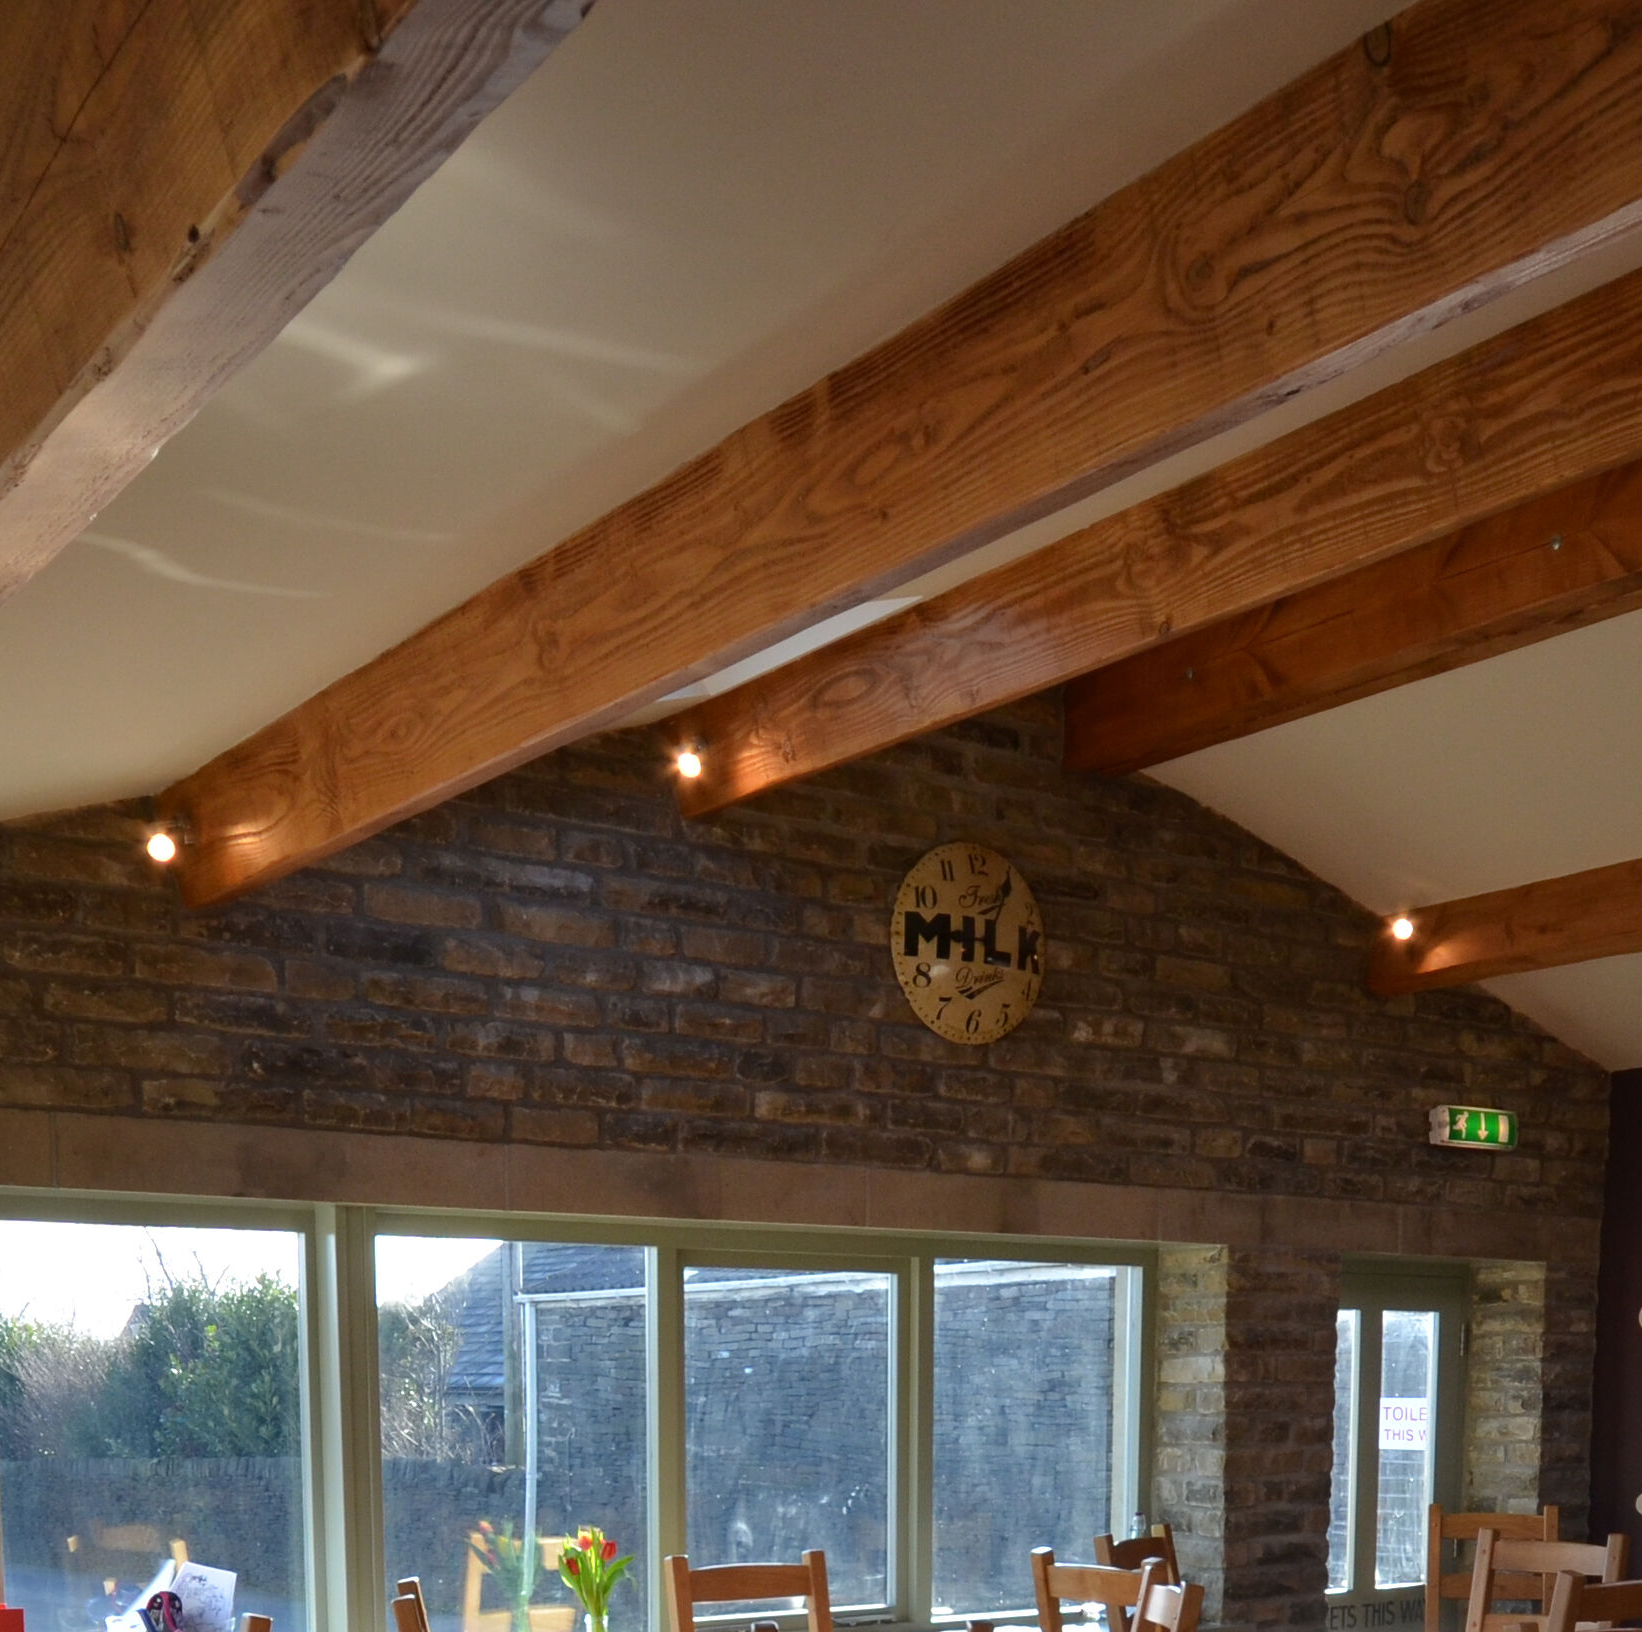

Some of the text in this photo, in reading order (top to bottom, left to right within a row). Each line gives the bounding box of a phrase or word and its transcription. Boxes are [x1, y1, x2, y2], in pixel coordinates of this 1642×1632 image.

[940, 859, 956, 882] 11
[967, 853, 989, 876] 12
[914, 885, 938, 909] 10
[904, 911, 1041, 975] MILK
[912, 962, 933, 988] 8
[936, 996, 952, 1020] 7
[996, 1003, 1010, 1028] 5
[965, 1009, 982, 1034] 6
[1382, 1406, 1428, 1421] TOILE
[1384, 1429, 1414, 1442] THIS
[1362, 1601, 1395, 1628] THIS
